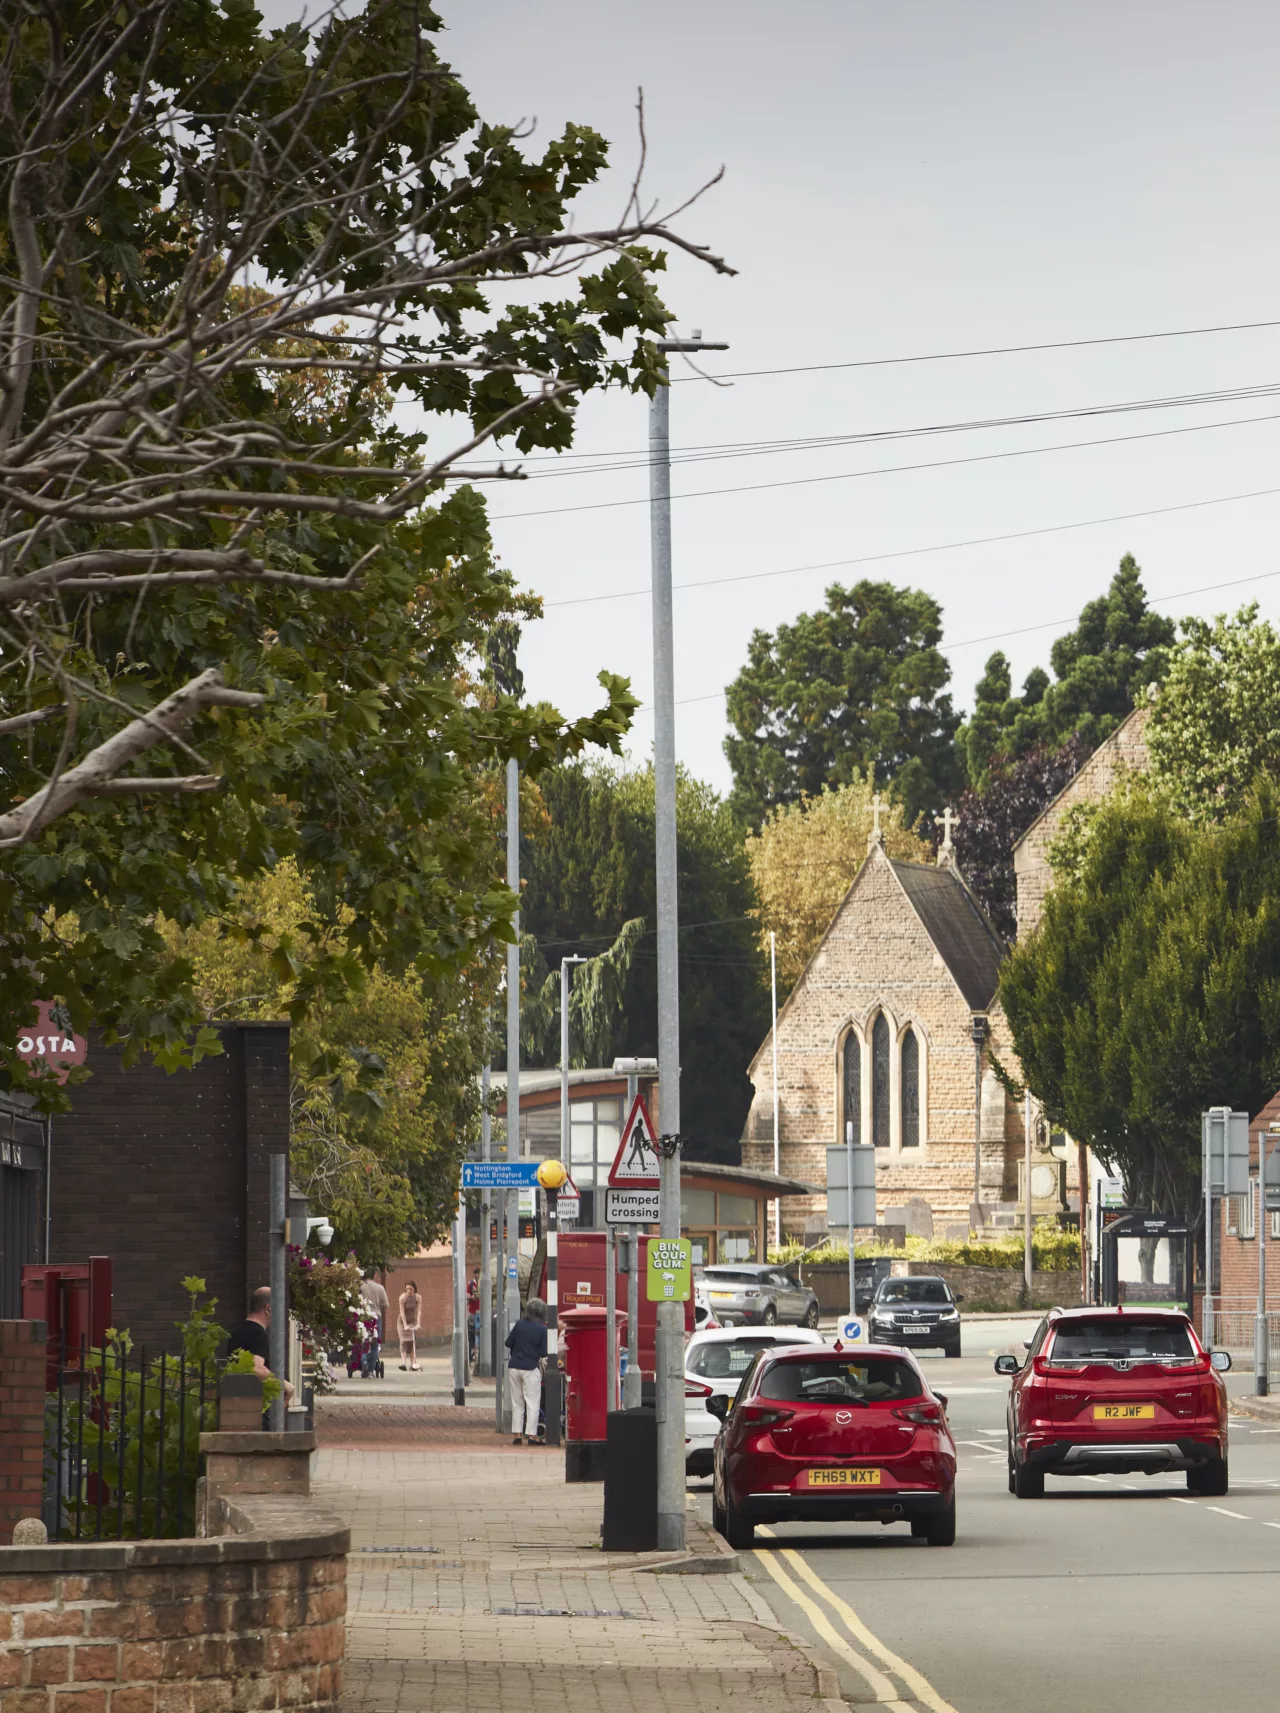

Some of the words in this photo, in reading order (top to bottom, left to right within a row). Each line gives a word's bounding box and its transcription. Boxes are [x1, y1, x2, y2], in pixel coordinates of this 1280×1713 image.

[17, 1036, 76, 1055] OSTA
[474, 1165, 512, 1173] Nottingham
[496, 1178, 530, 1186] Pierrepont
[611, 1193, 659, 1206] Humped
[557, 1201, 576, 1209] lderly
[611, 1208, 659, 1219] crossing
[659, 1242, 680, 1251] BIN
[652, 1251, 687, 1260] YOUR
[653, 1260, 685, 1269] GUM.
[566, 1295, 585, 1303] Royal
[586, 1295, 601, 1303] Mail
[1105, 1407, 1118, 1417] R2
[1122, 1406, 1142, 1417] JWF
[813, 1470, 847, 1483] FH69
[850, 1470, 875, 1482] WXT
